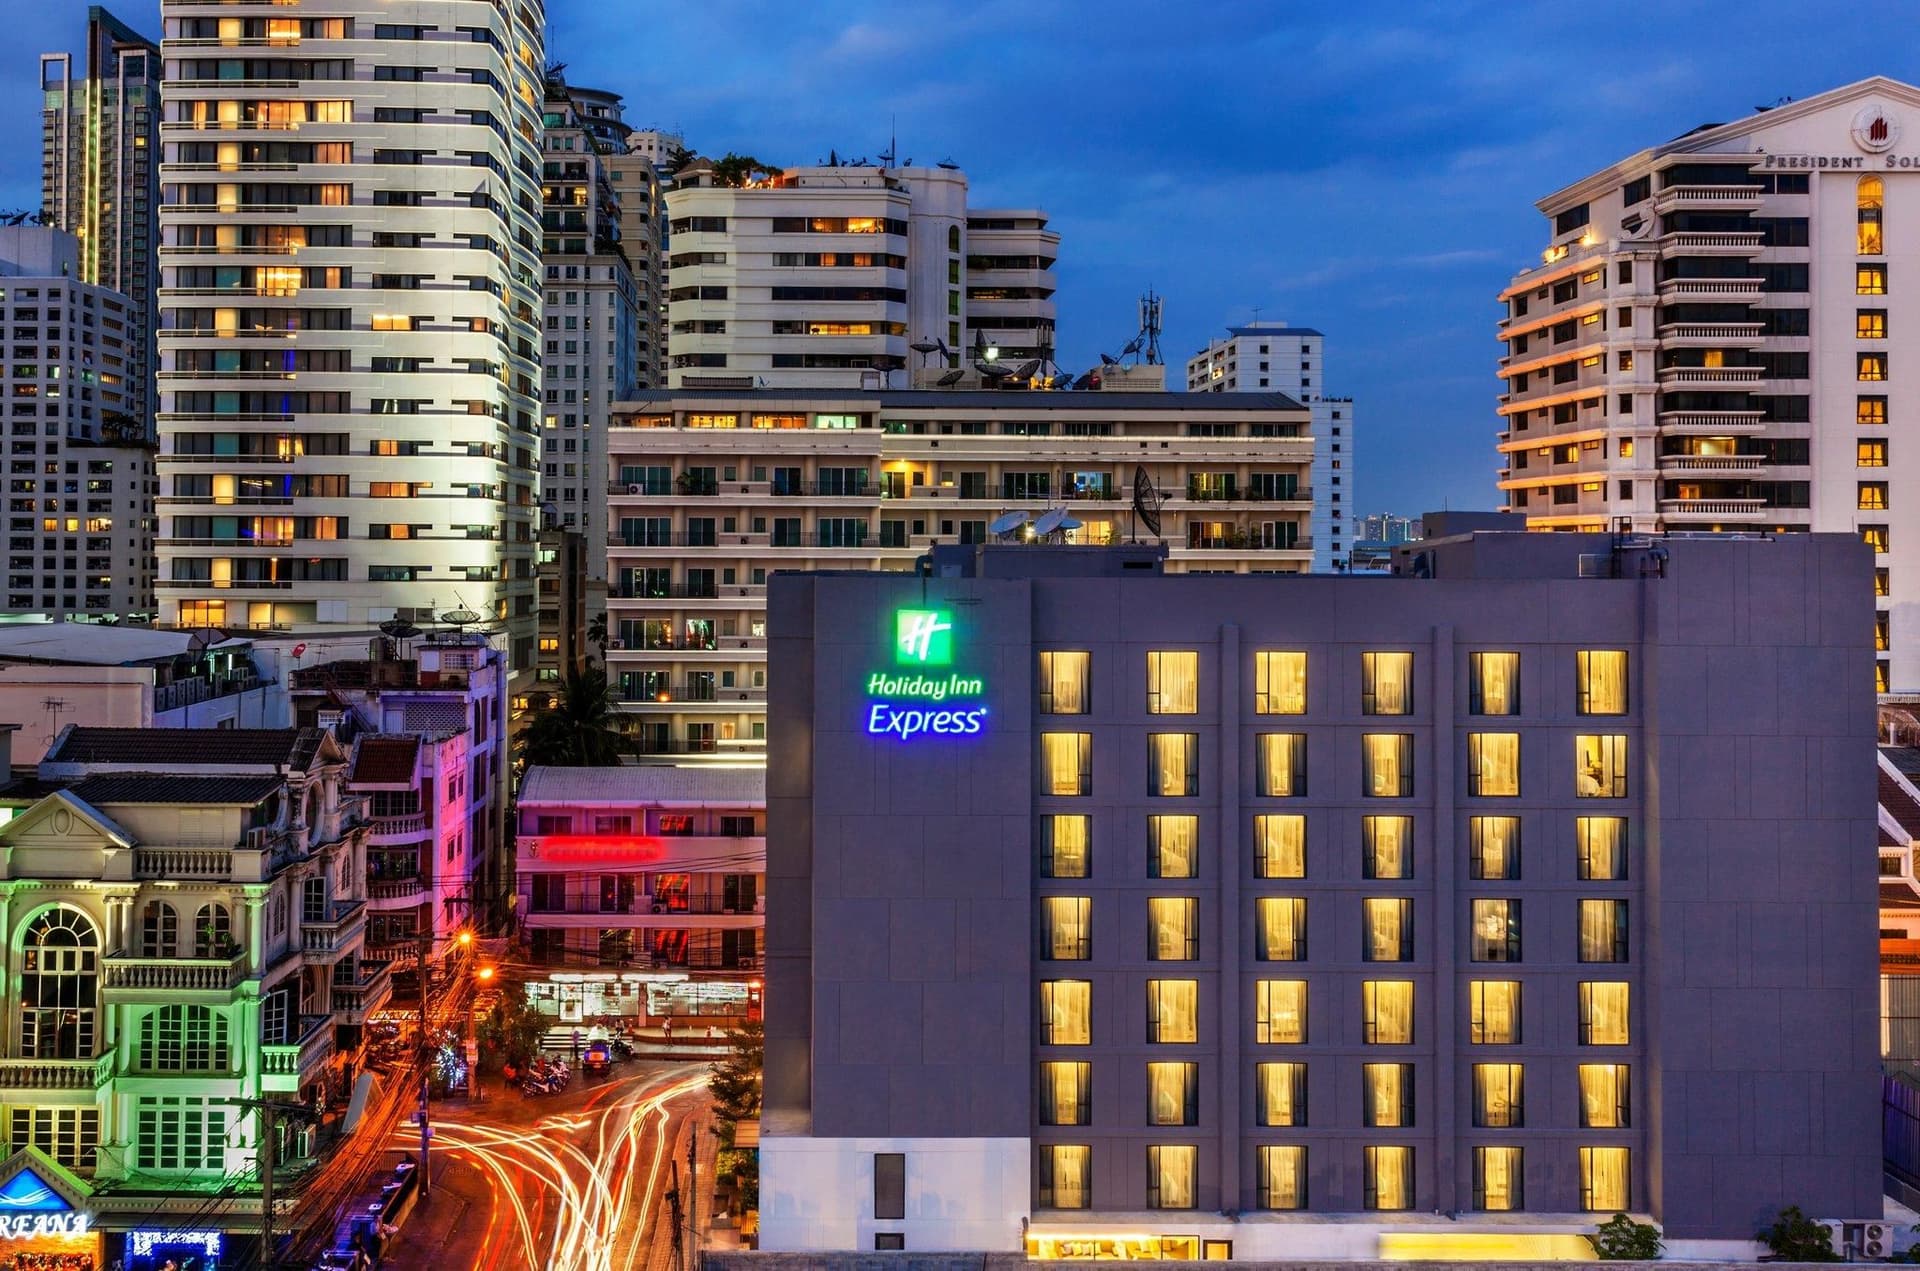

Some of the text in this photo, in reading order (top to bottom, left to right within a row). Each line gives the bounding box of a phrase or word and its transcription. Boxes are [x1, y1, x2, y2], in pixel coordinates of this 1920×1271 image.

[1765, 155, 1864, 168] PRESIDENT
[868, 673, 982, 700] Holiday Inn
[868, 704, 985, 740] Express
